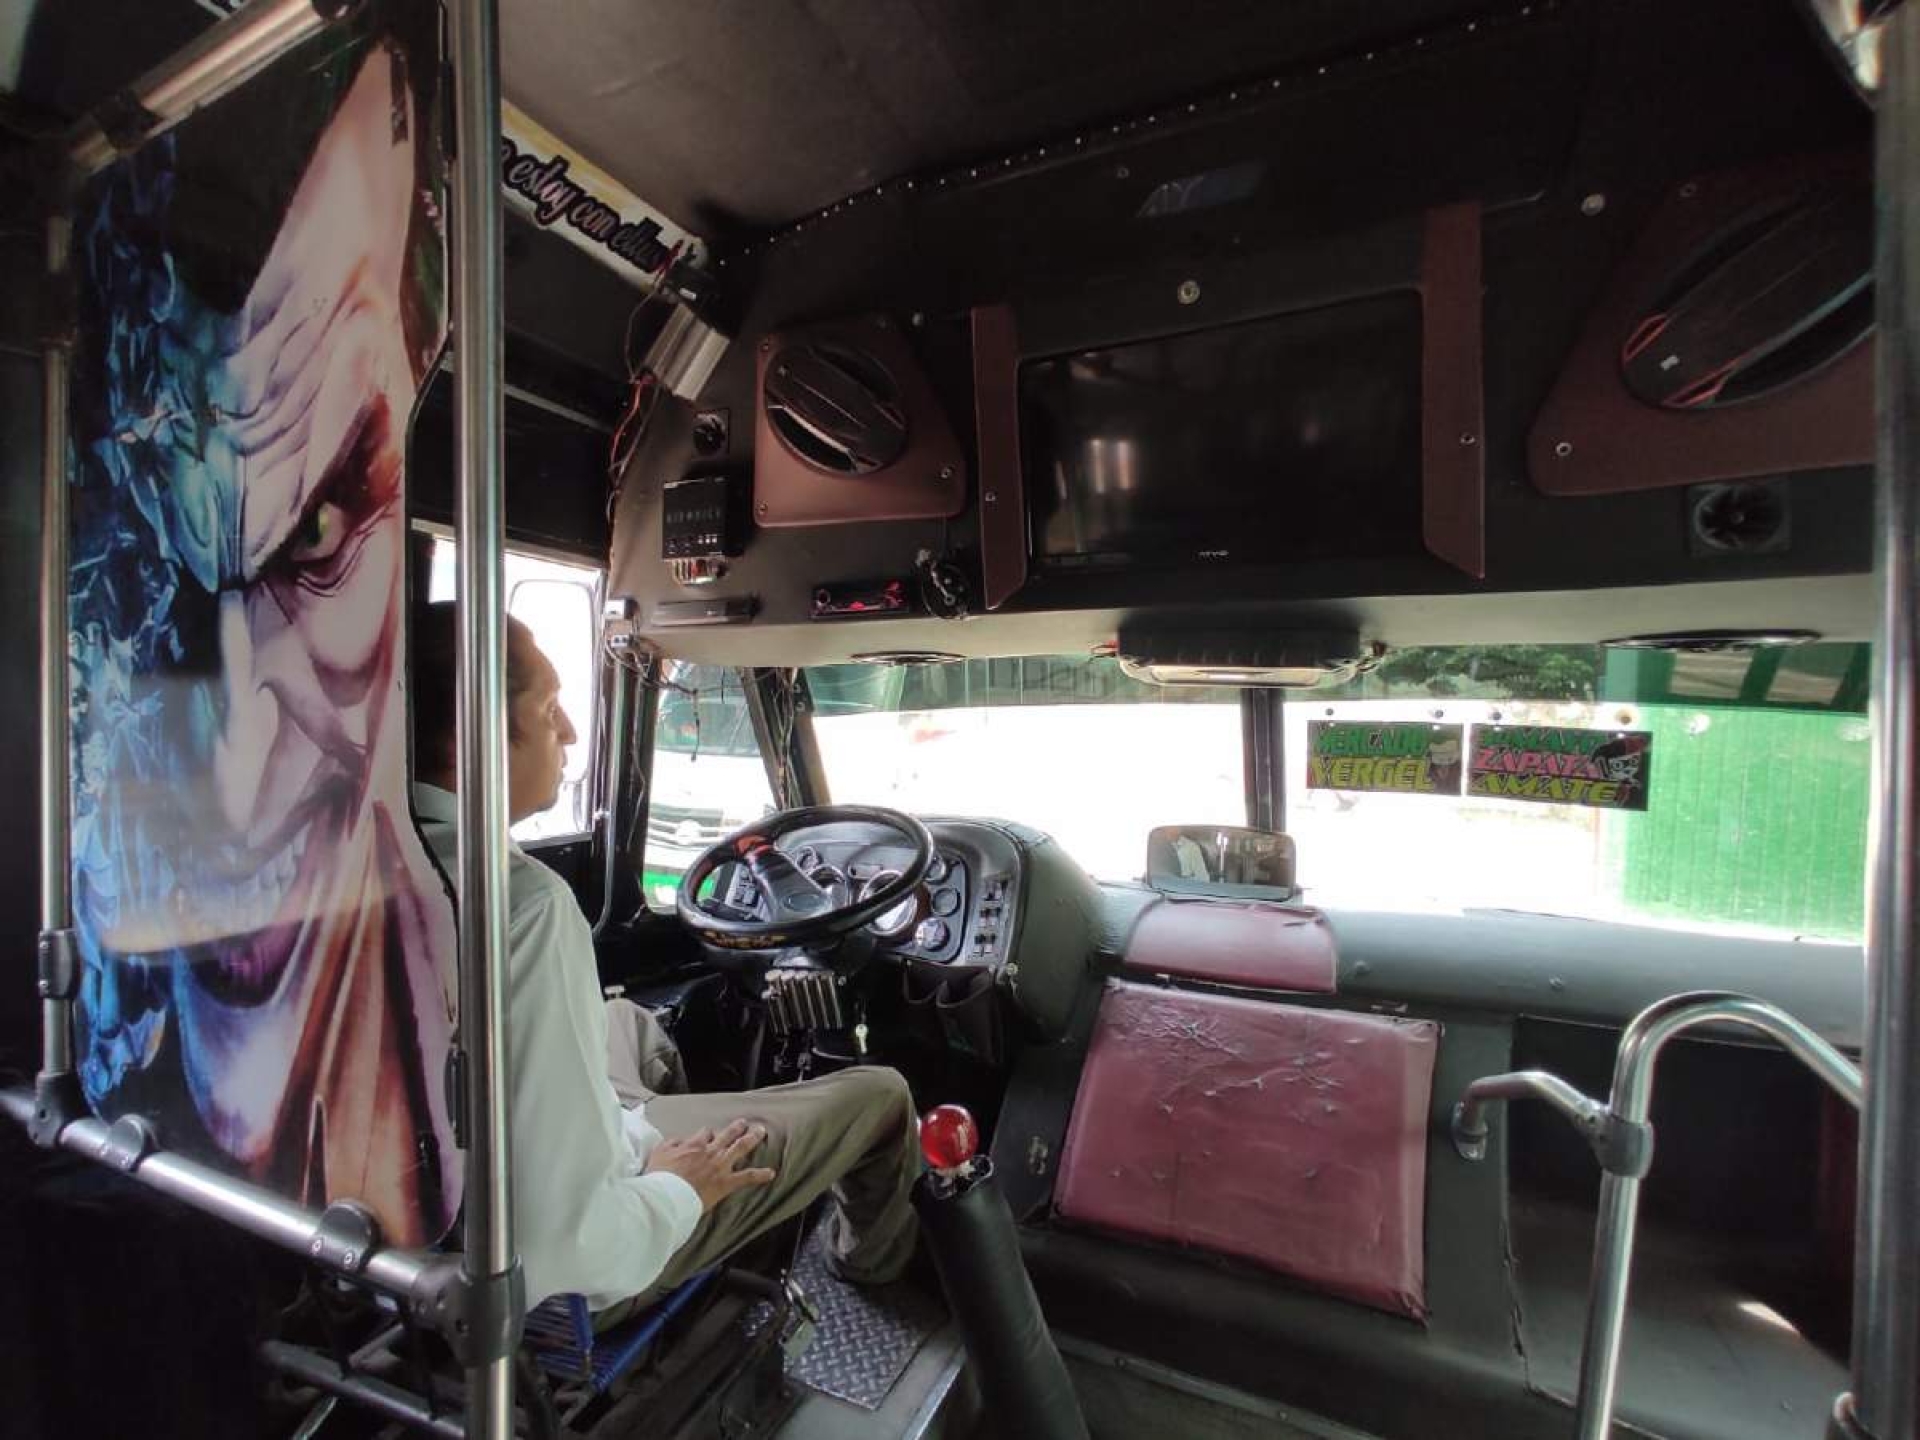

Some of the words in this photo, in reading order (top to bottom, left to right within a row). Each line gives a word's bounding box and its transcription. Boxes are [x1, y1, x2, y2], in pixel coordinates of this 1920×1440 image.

[502, 157, 580, 223] estoy
[568, 198, 618, 240] con
[1311, 756, 1434, 792] VERGEL
[1473, 747, 1608, 779] ZAPATA
[1471, 771, 1619, 804] AMATE
